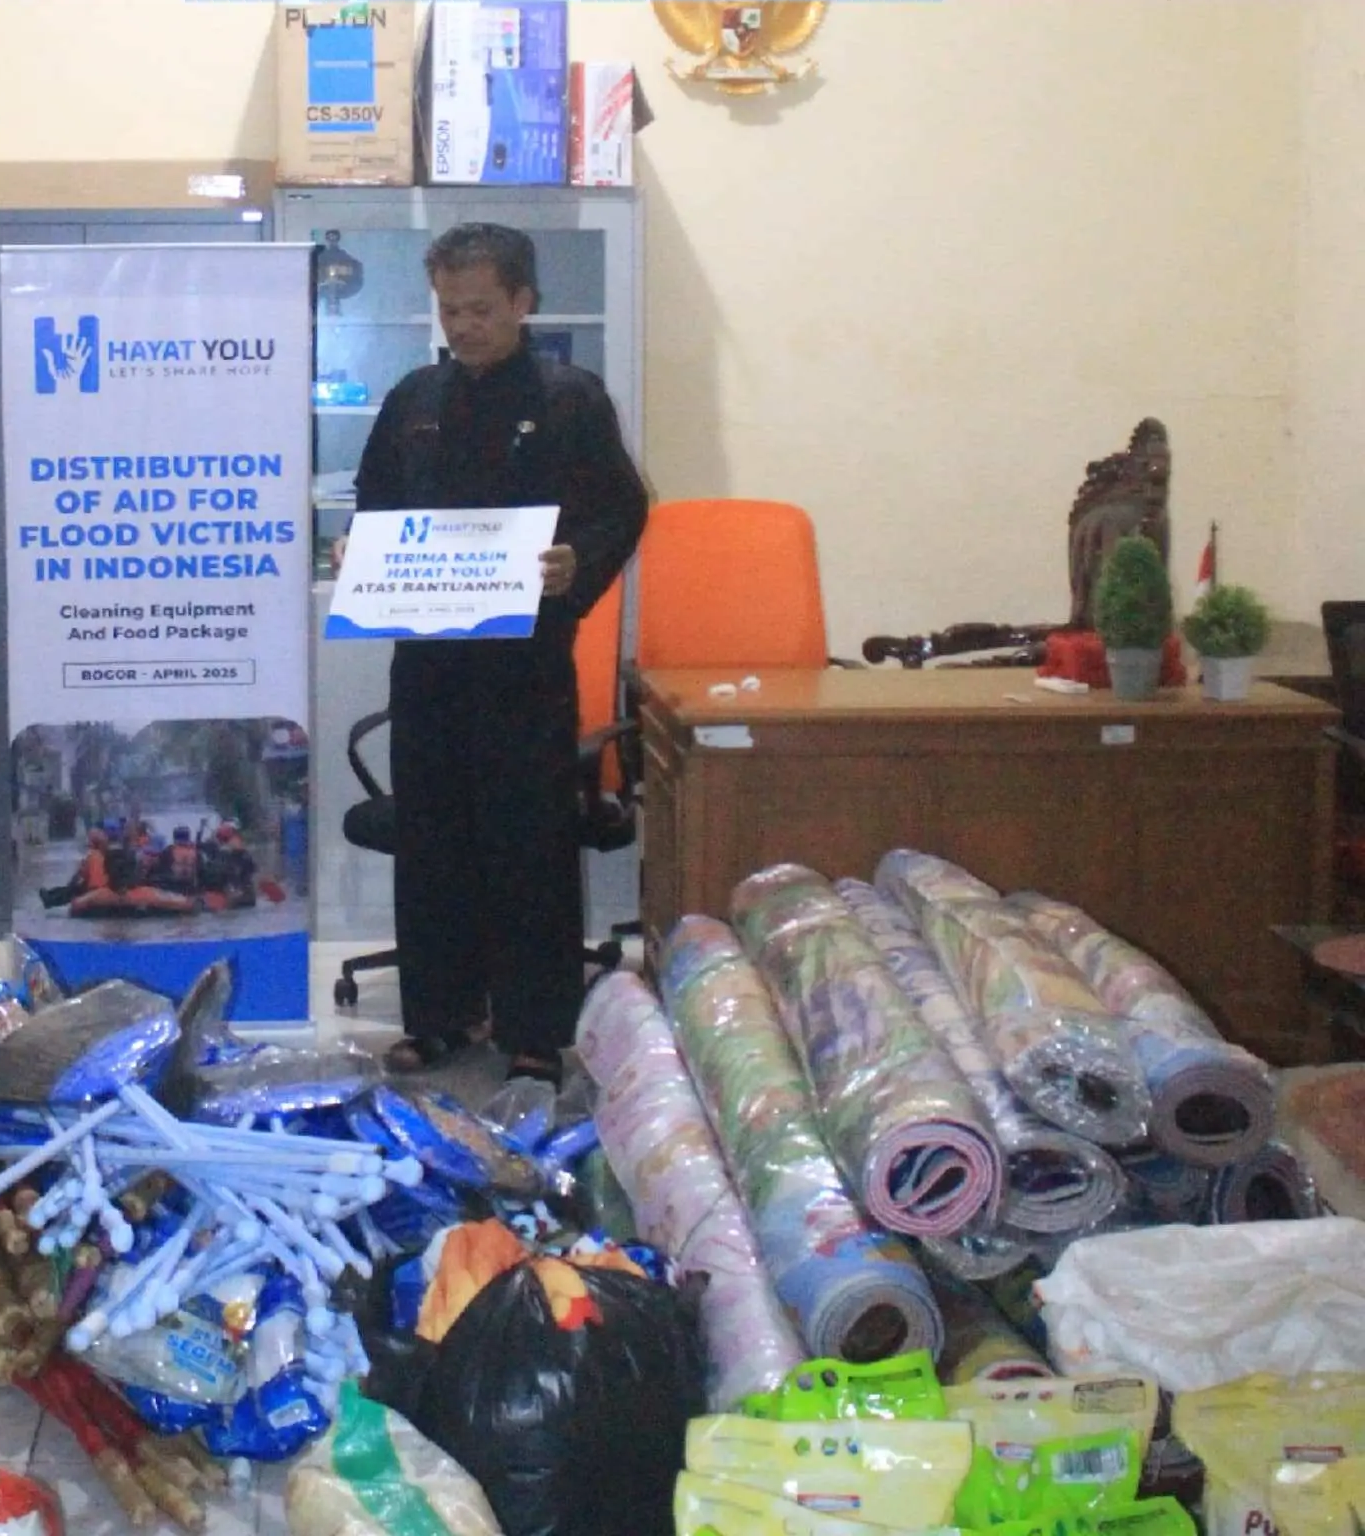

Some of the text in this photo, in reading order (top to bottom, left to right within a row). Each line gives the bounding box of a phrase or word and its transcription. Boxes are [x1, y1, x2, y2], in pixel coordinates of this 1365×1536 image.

[306, 106, 384, 122] CS-350V
[436, 120, 450, 175] EPSON
[108, 338, 275, 361] HAYAT YOLU
[30, 454, 282, 482] DISTRIBUTION
[55, 488, 258, 514] OF AID FOR
[20, 520, 294, 548] FLOOD VICTIMS
[35, 554, 280, 582] IN INDONESIA
[384, 553, 448, 564] TERIMA
[352, 581, 525, 594] ATAS BANTUANNYA
[60, 602, 255, 620] Cleaning Equipment
[68, 625, 248, 641] And Food Package
[153, 669, 197, 679] APRIL
[202, 668, 238, 678] 2025
